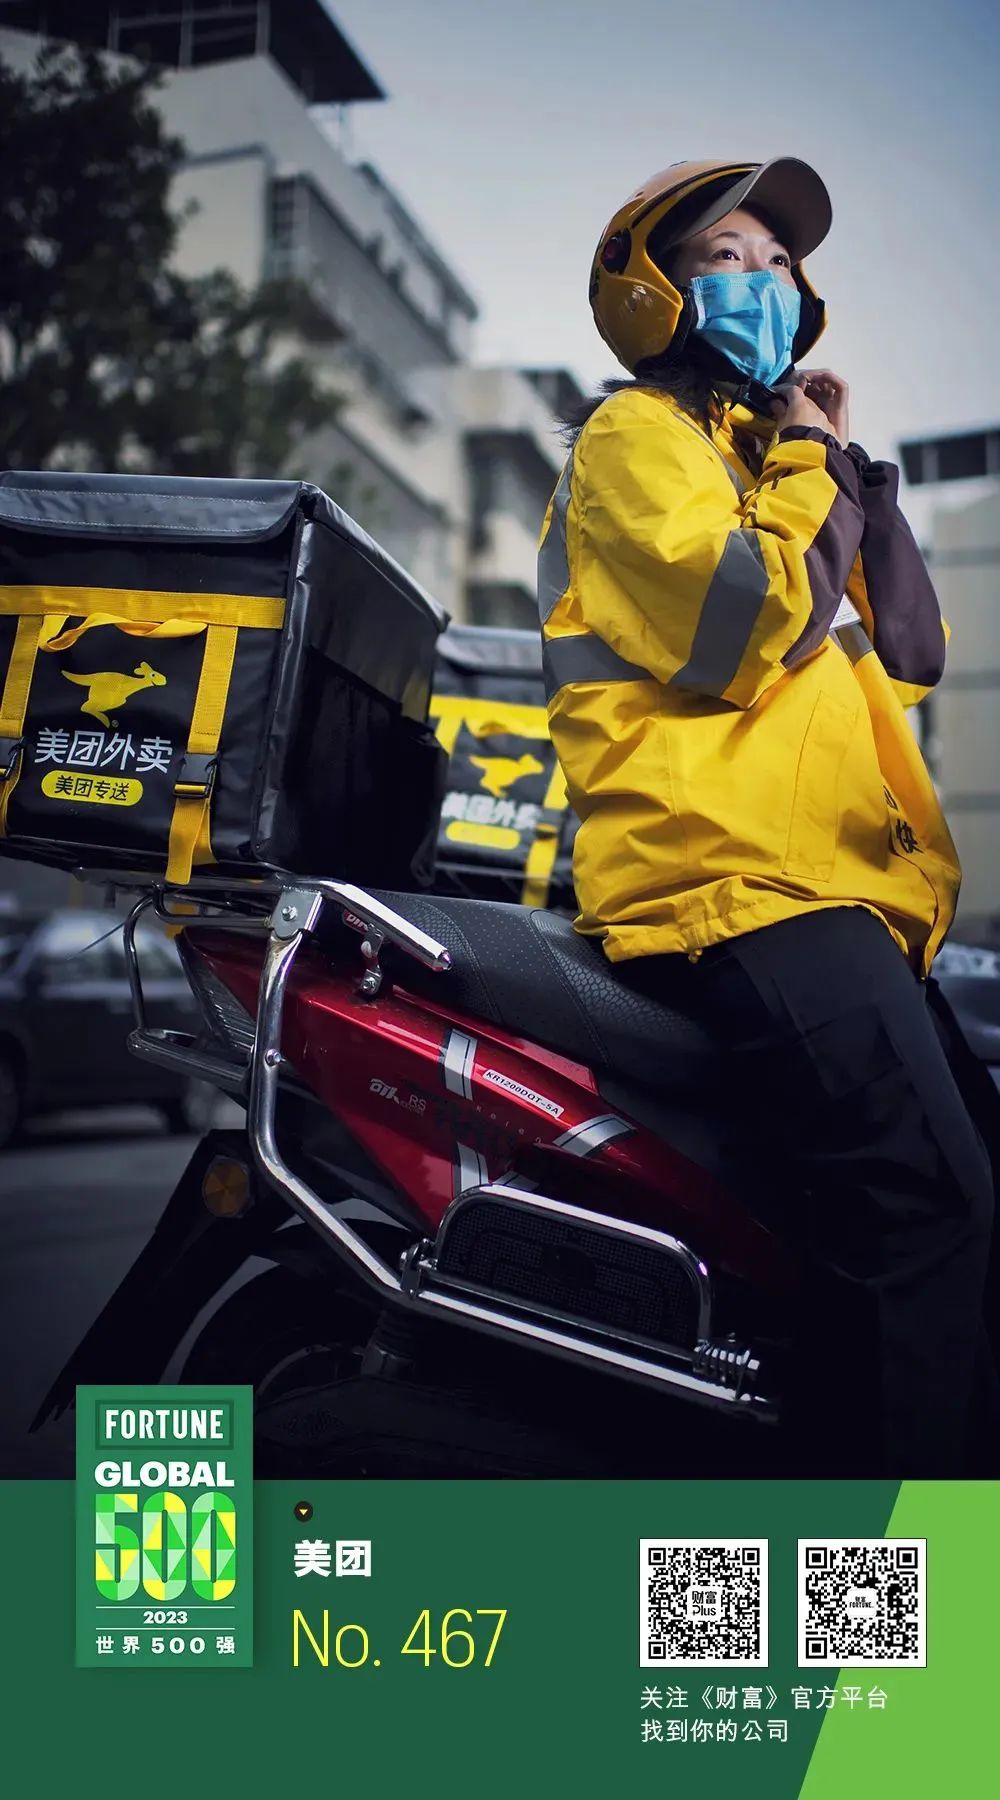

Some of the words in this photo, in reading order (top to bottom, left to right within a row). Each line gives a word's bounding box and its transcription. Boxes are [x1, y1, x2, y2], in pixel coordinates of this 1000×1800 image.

[34, 728, 172, 774] 美团外卖
[55, 775, 129, 801] 美团专送
[486, 1070, 560, 1116] KR1200DQT-5A
